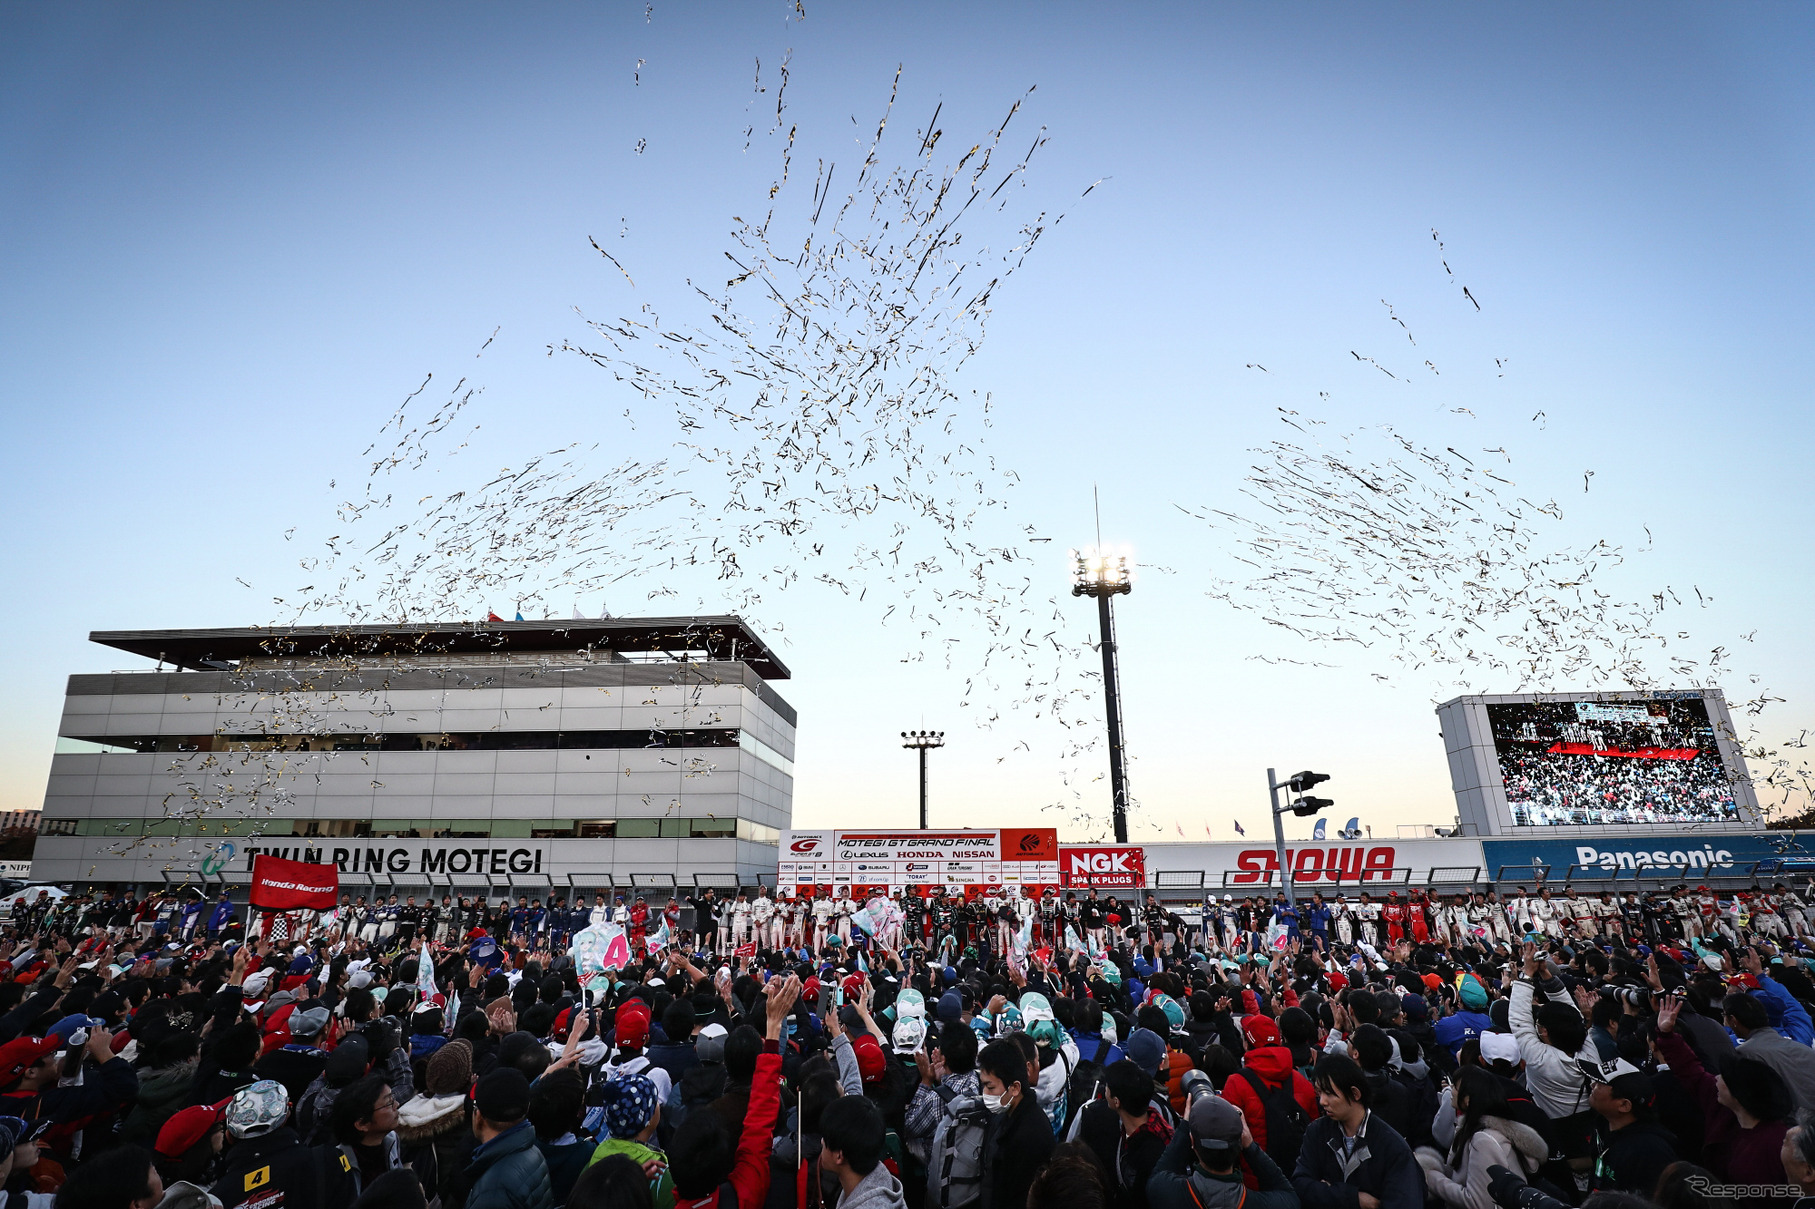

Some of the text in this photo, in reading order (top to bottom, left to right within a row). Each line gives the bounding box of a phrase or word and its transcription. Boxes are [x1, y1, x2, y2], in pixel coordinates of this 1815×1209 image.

[837, 839, 994, 847] MOTEGI GT GRAND FINAL
[332, 848, 411, 873] RING
[420, 848, 543, 874] MOTEGI
[952, 850, 995, 858] NISSAN
[1071, 852, 1130, 875] NGK
[1576, 844, 1734, 871] Panasonic
[1233, 846, 1396, 883] SHOWA
[261, 878, 336, 893] Honda Racing
[1102, 876, 1132, 884] PLUGS
[603, 933, 630, 970] 4
[251, 1170, 263, 1185] 4
